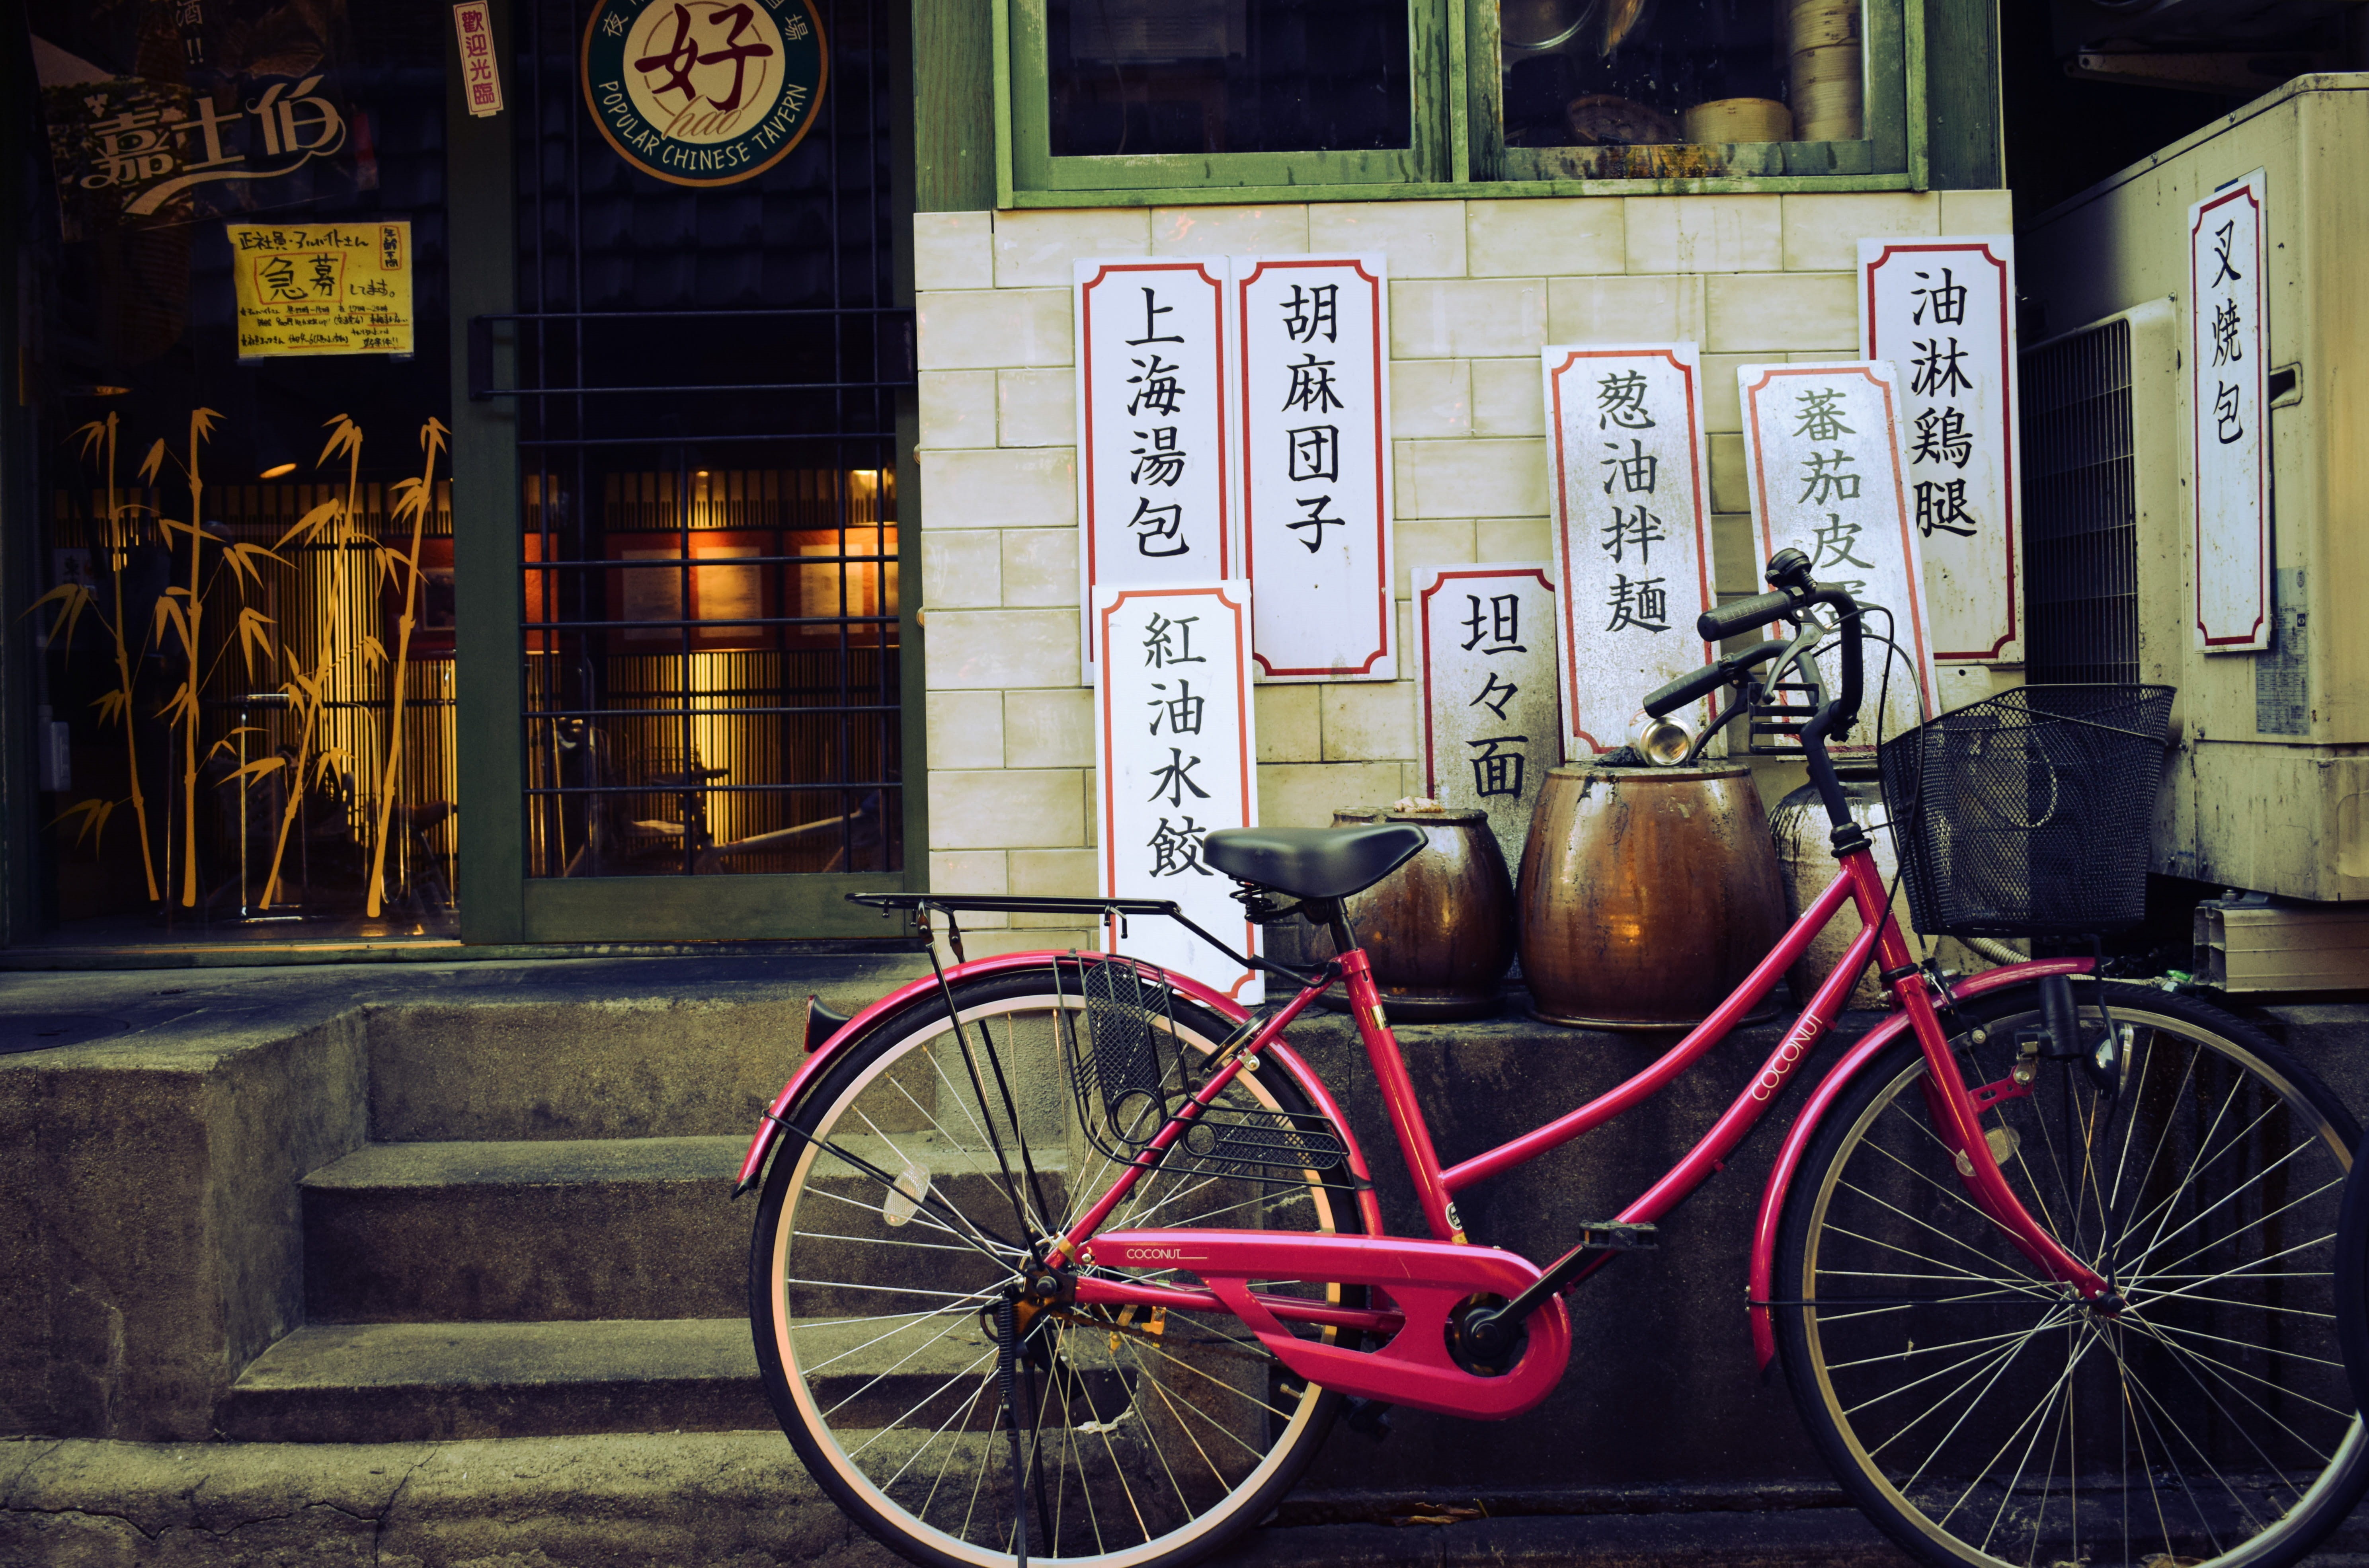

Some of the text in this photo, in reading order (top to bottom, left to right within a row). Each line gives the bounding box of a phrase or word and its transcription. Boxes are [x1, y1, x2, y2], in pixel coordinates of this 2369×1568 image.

[462, 10, 495, 105] 歡迎光臨
[634, 4, 773, 111] 好
[81, 75, 345, 199] 嘉士伯
[599, 80, 808, 170] POPULAR CHINESE TAVERN
[662, 94, 742, 140] hao
[259, 253, 339, 301] 急募
[2211, 219, 2243, 445] 叉焼包
[1125, 287, 1190, 557] 上海湯包
[1279, 284, 1346, 553] 胡麻団子
[1910, 268, 1978, 538] 油淋鶏腿
[1596, 370, 1672, 634] 葱油拌麺
[1143, 612, 1214, 878] 紅油水餃
[1752, 1011, 1823, 1101] COCONUT
[1126, 1248, 1181, 1259] COCONUT
